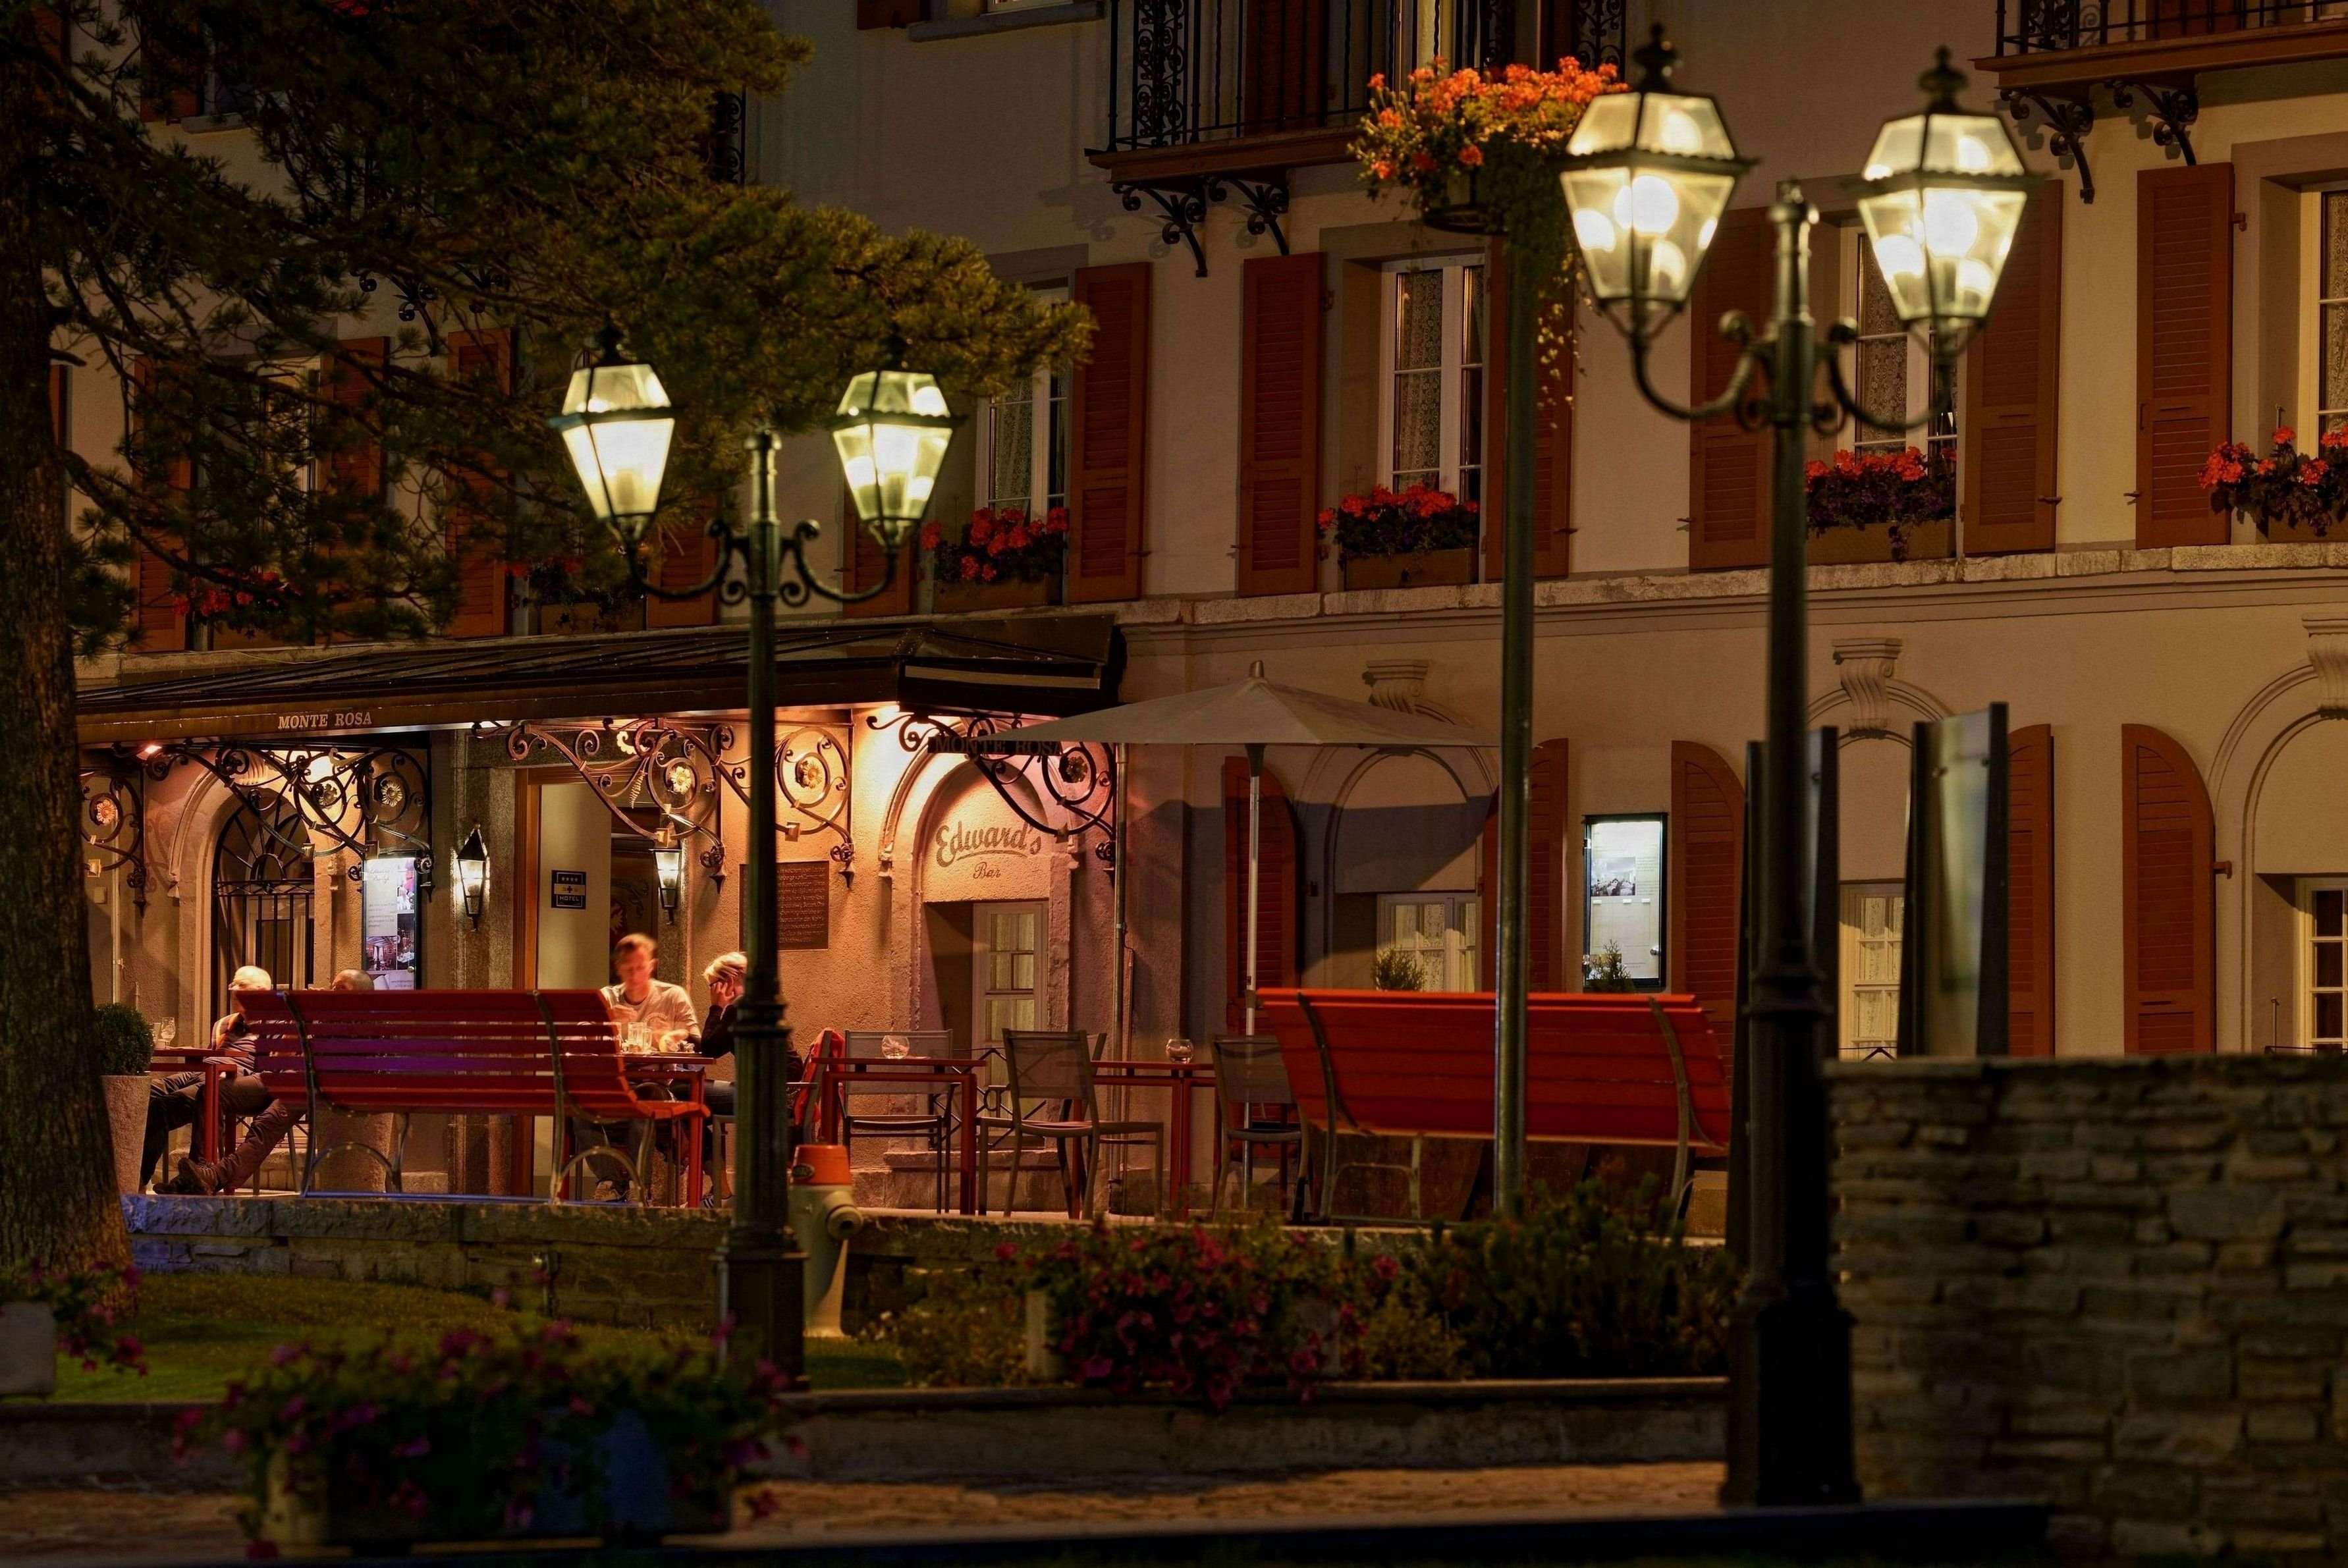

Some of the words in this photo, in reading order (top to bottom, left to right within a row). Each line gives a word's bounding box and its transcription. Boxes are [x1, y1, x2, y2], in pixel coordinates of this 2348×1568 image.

[278, 714, 328, 730] MONTE
[335, 711, 372, 727] ROSA
[936, 737, 1005, 754] MONTE
[936, 821, 1041, 867] Edward's
[972, 861, 1001, 879] Bar
